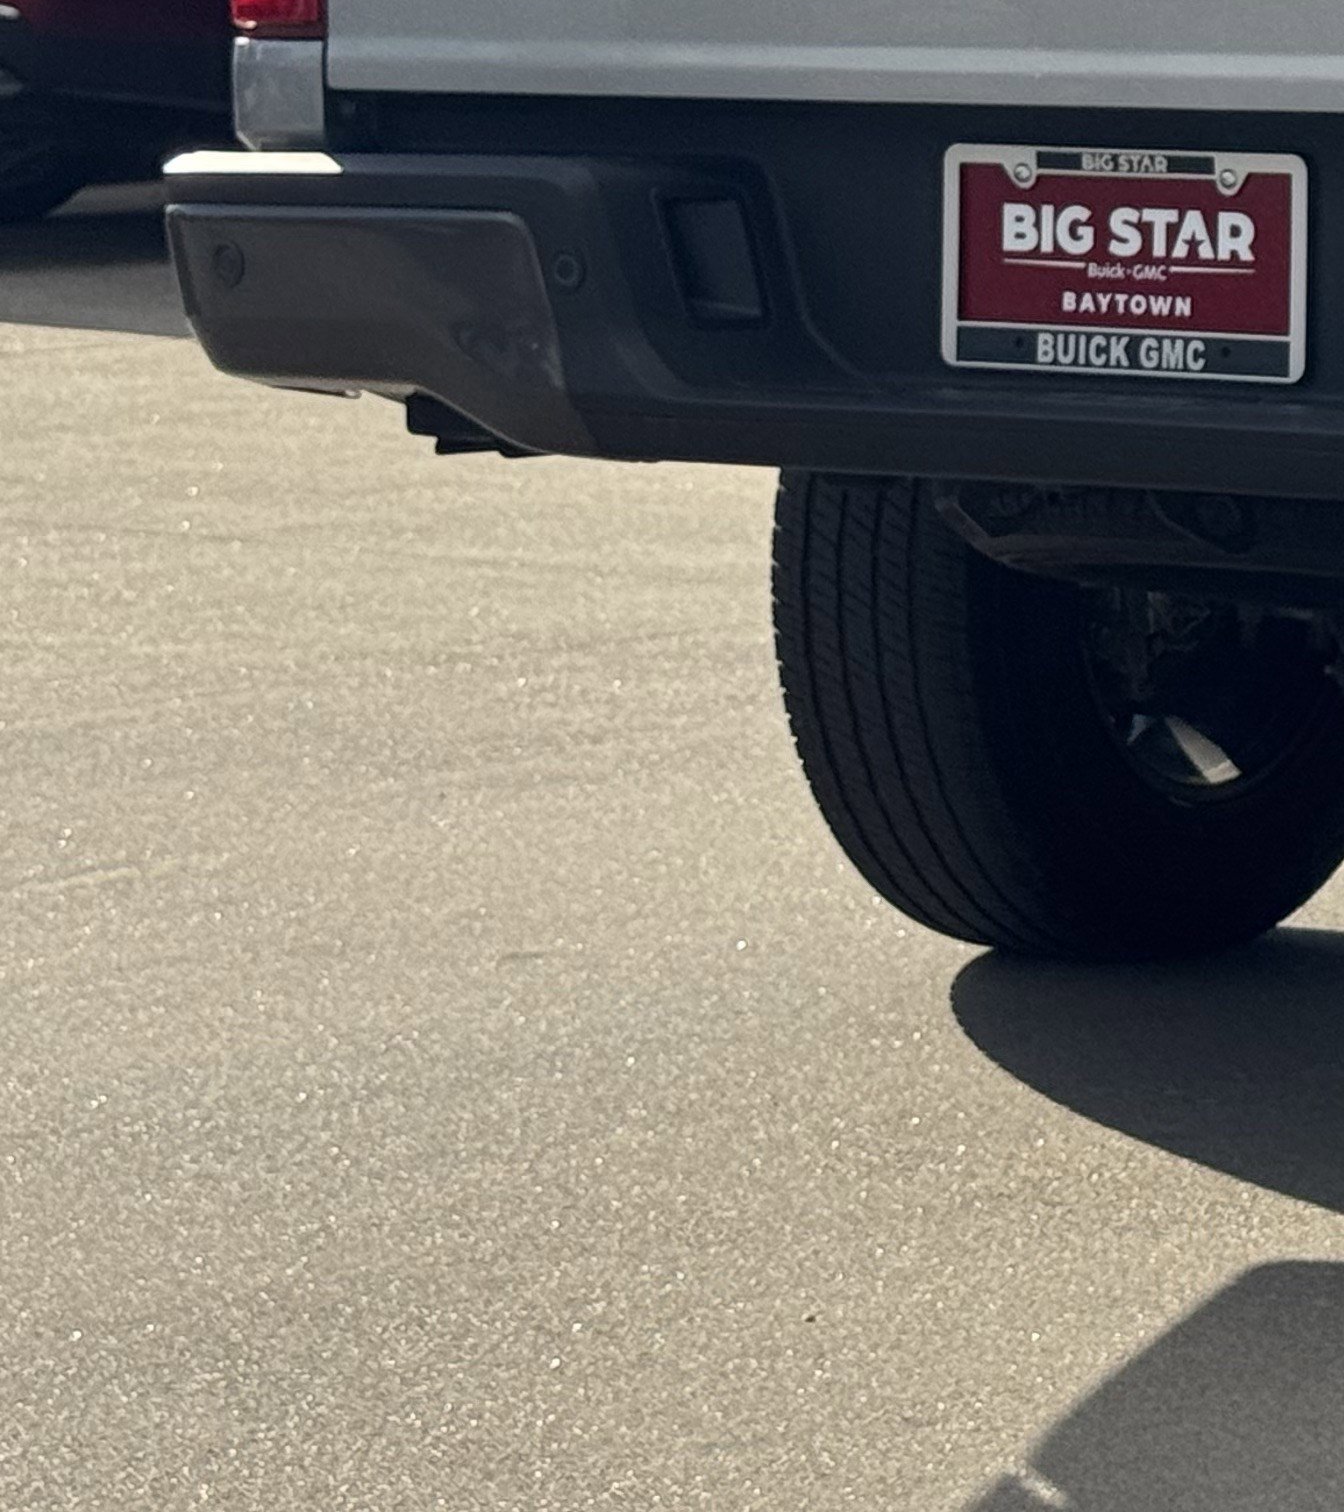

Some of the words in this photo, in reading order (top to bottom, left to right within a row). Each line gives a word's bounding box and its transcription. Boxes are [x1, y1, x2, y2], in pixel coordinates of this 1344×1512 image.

[1082, 152, 1115, 171] BIG
[1118, 154, 1168, 173] STAR
[1002, 201, 1095, 255] BIG
[1108, 206, 1256, 262] STAR
[1061, 291, 1193, 317] BAYTOWN
[1036, 331, 1130, 368] BUICK
[1139, 337, 1206, 371] GMC
